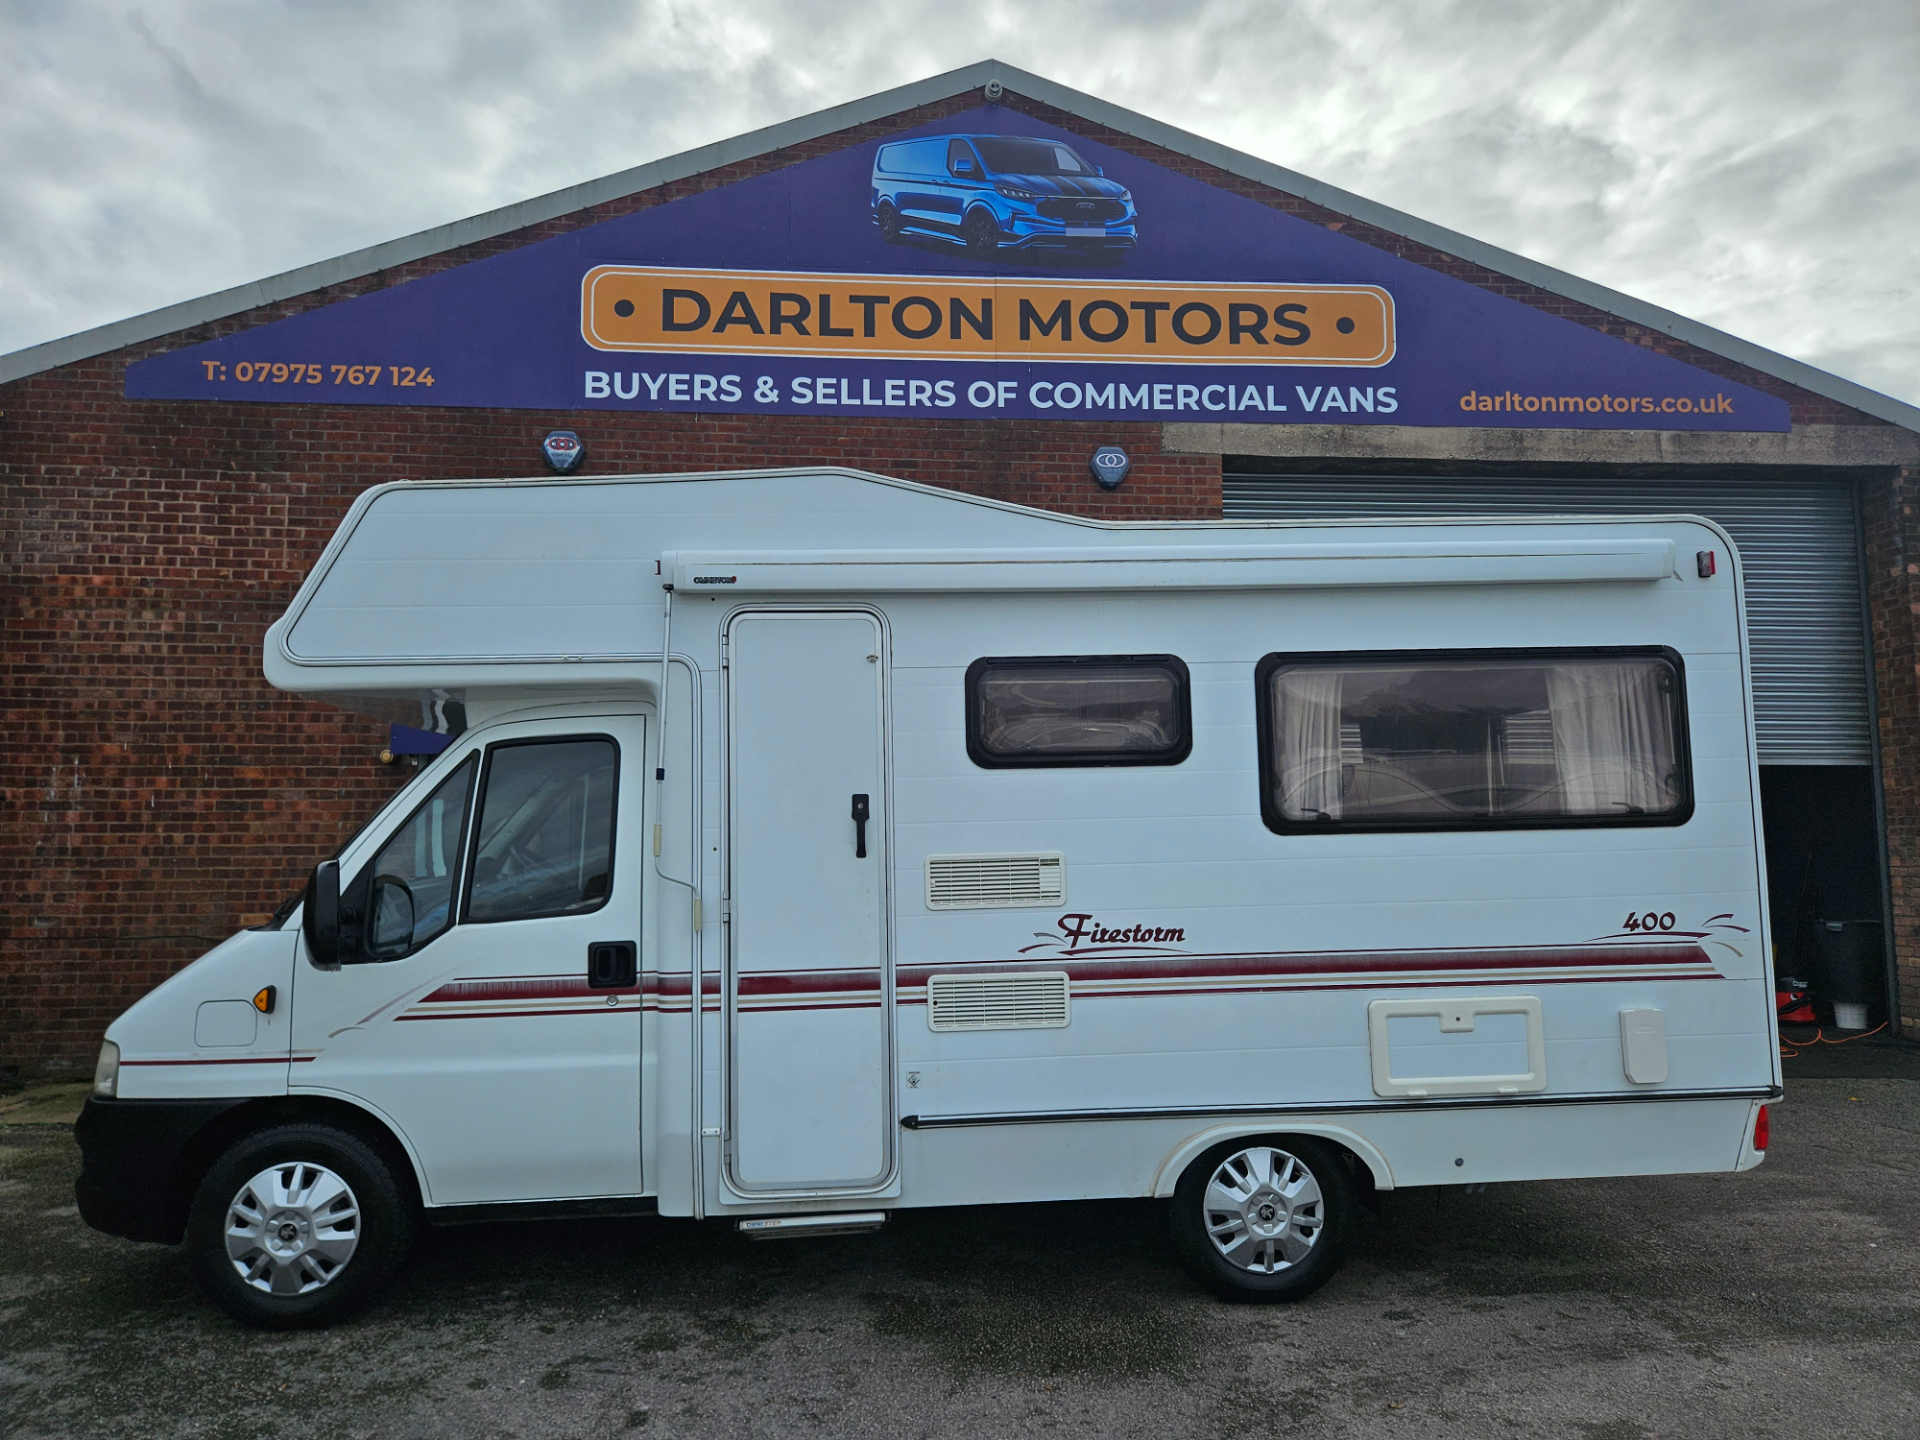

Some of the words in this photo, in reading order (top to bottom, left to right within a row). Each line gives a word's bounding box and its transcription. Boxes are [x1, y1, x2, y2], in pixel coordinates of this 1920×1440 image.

[661, 288, 994, 341] DARLTON
[1018, 297, 1312, 346] MOTORS
[201, 360, 226, 382] T:
[234, 361, 323, 385] 07975
[330, 364, 382, 386] 767
[389, 366, 436, 388] 124
[584, 370, 742, 403] BUYERS
[754, 376, 780, 404] &
[790, 375, 957, 408] SELLERS
[967, 380, 1018, 408] OF
[1028, 381, 1288, 412] COMMERCIAL
[1295, 384, 1399, 414] VANS
[1459, 390, 1734, 415] darltonmotors.co.uk
[1057, 913, 1186, 949] Firestorm
[1622, 911, 1676, 932] 400
